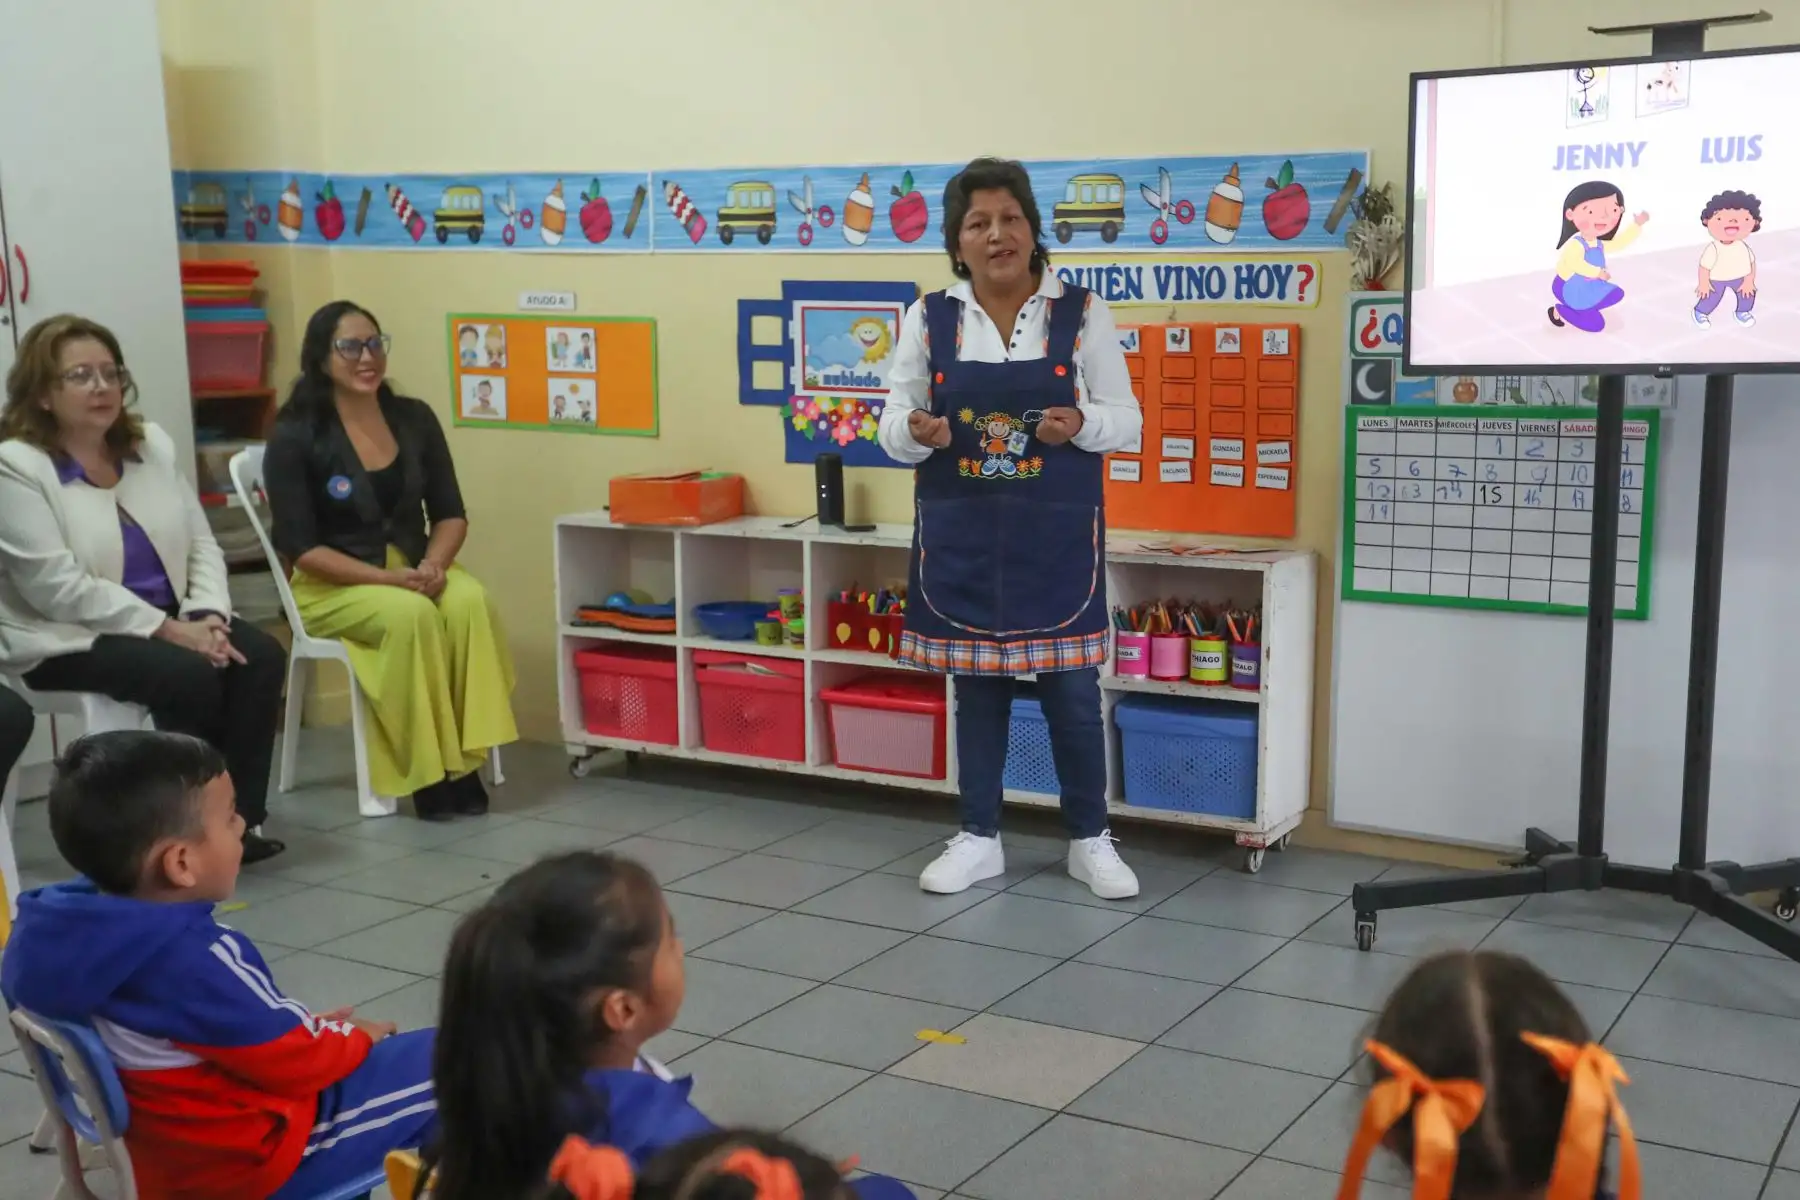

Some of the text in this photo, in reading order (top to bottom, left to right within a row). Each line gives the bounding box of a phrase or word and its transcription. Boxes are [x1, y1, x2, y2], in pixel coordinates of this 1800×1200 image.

[1552, 141, 1648, 171] JENNY
[1700, 134, 1764, 165] LUIS
[1153, 264, 1226, 301] VINO
[1234, 263, 1315, 302] HOY?
[823, 370, 881, 388] nublado
[1363, 419, 1389, 427] LUNES
[1399, 419, 1434, 428] MARTES
[1437, 419, 1477, 429] MIÉRCOLES
[1482, 421, 1513, 430] JUEVES
[1520, 424, 1556, 433] VIERNES
[1212, 444, 1241, 453] GONZALO
[1495, 437, 1502, 455] 1
[1524, 438, 1545, 458] 2
[1570, 439, 1584, 457] 3
[1213, 470, 1241, 479] ABRAHAM
[1257, 473, 1286, 481] ESPERANZA
[1369, 458, 1381, 475] 5
[1409, 460, 1420, 476] 6
[1448, 464, 1468, 478] 7
[1484, 463, 1498, 481] 8
[1531, 466, 1548, 492] 9
[1570, 464, 1588, 484] 10
[1367, 481, 1391, 499] 12
[1480, 484, 1502, 504] 15
[1572, 488, 1585, 508] 17
[1621, 494, 1632, 512] 8
